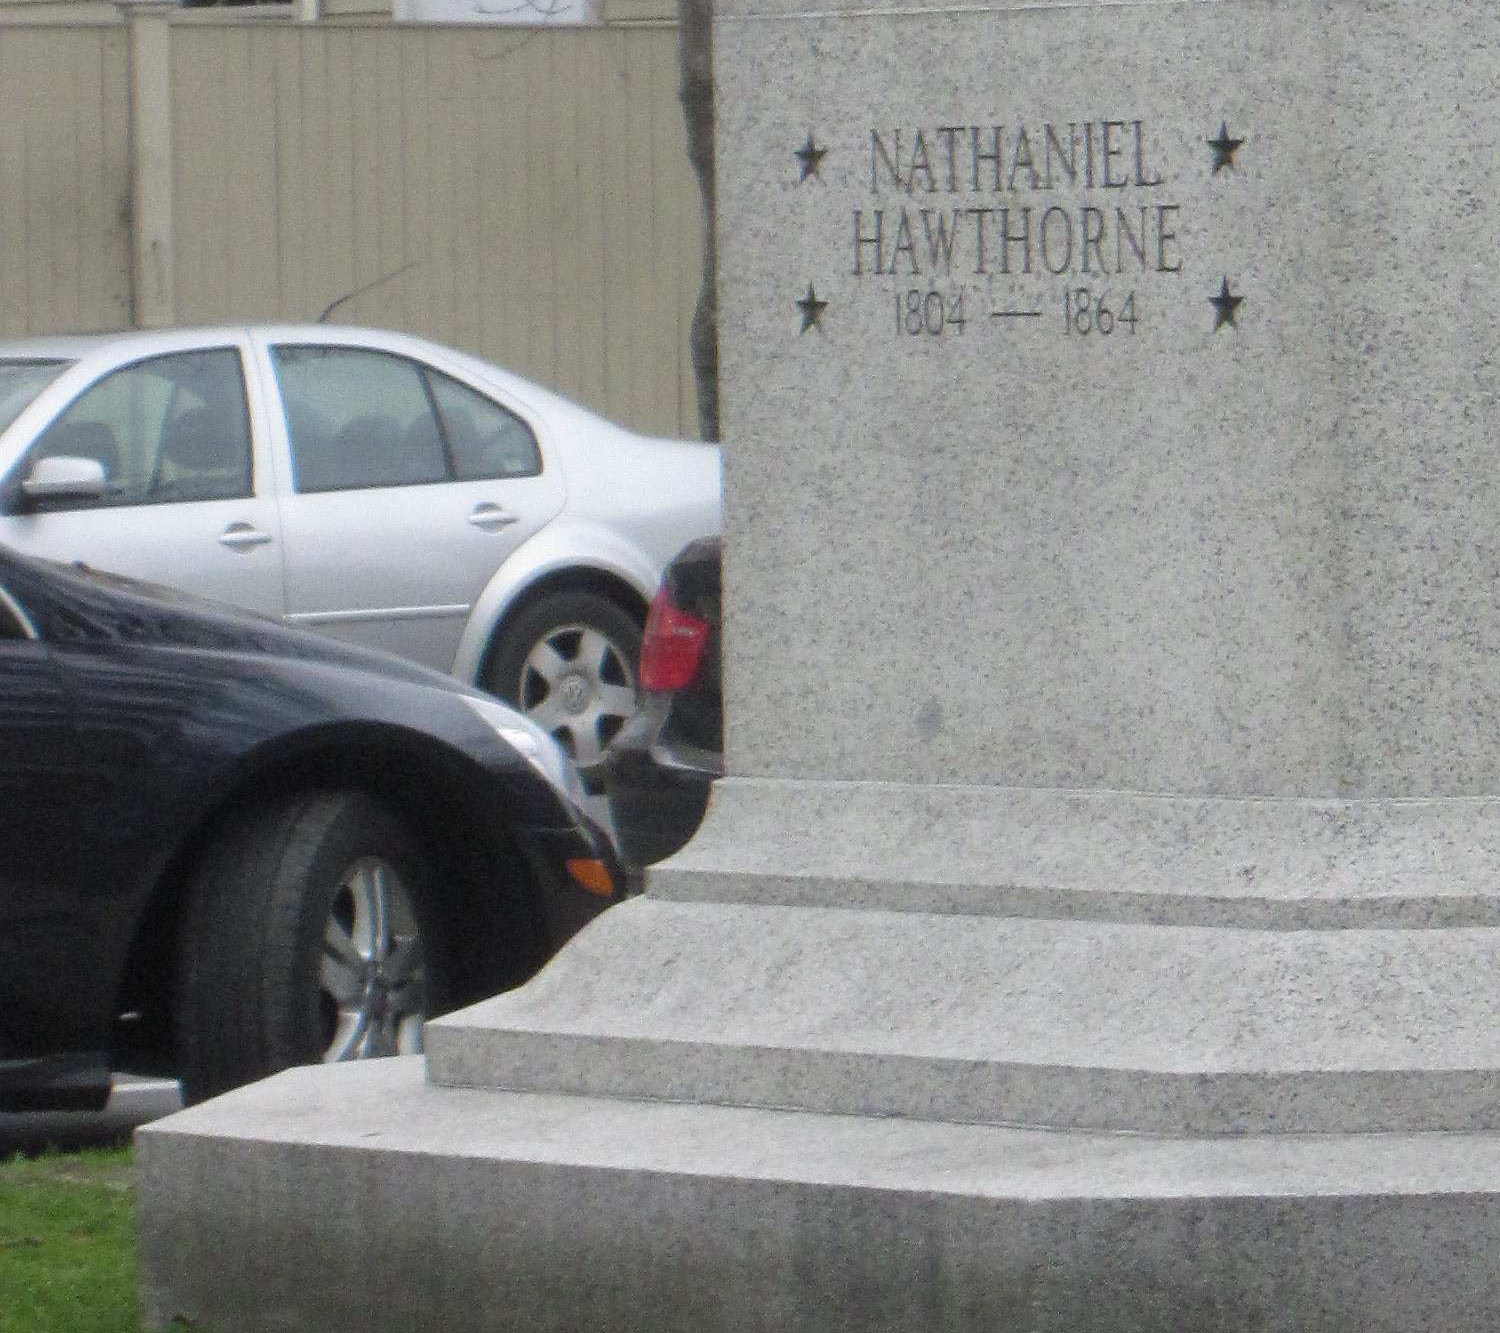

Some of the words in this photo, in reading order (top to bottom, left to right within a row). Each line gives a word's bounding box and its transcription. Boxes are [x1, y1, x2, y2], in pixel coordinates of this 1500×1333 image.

[869, 119, 1165, 194] NATHANIEL
[851, 204, 1183, 276] HAWTHORNE
[894, 287, 967, 337] 1804
[1062, 286, 1140, 337] 1864
